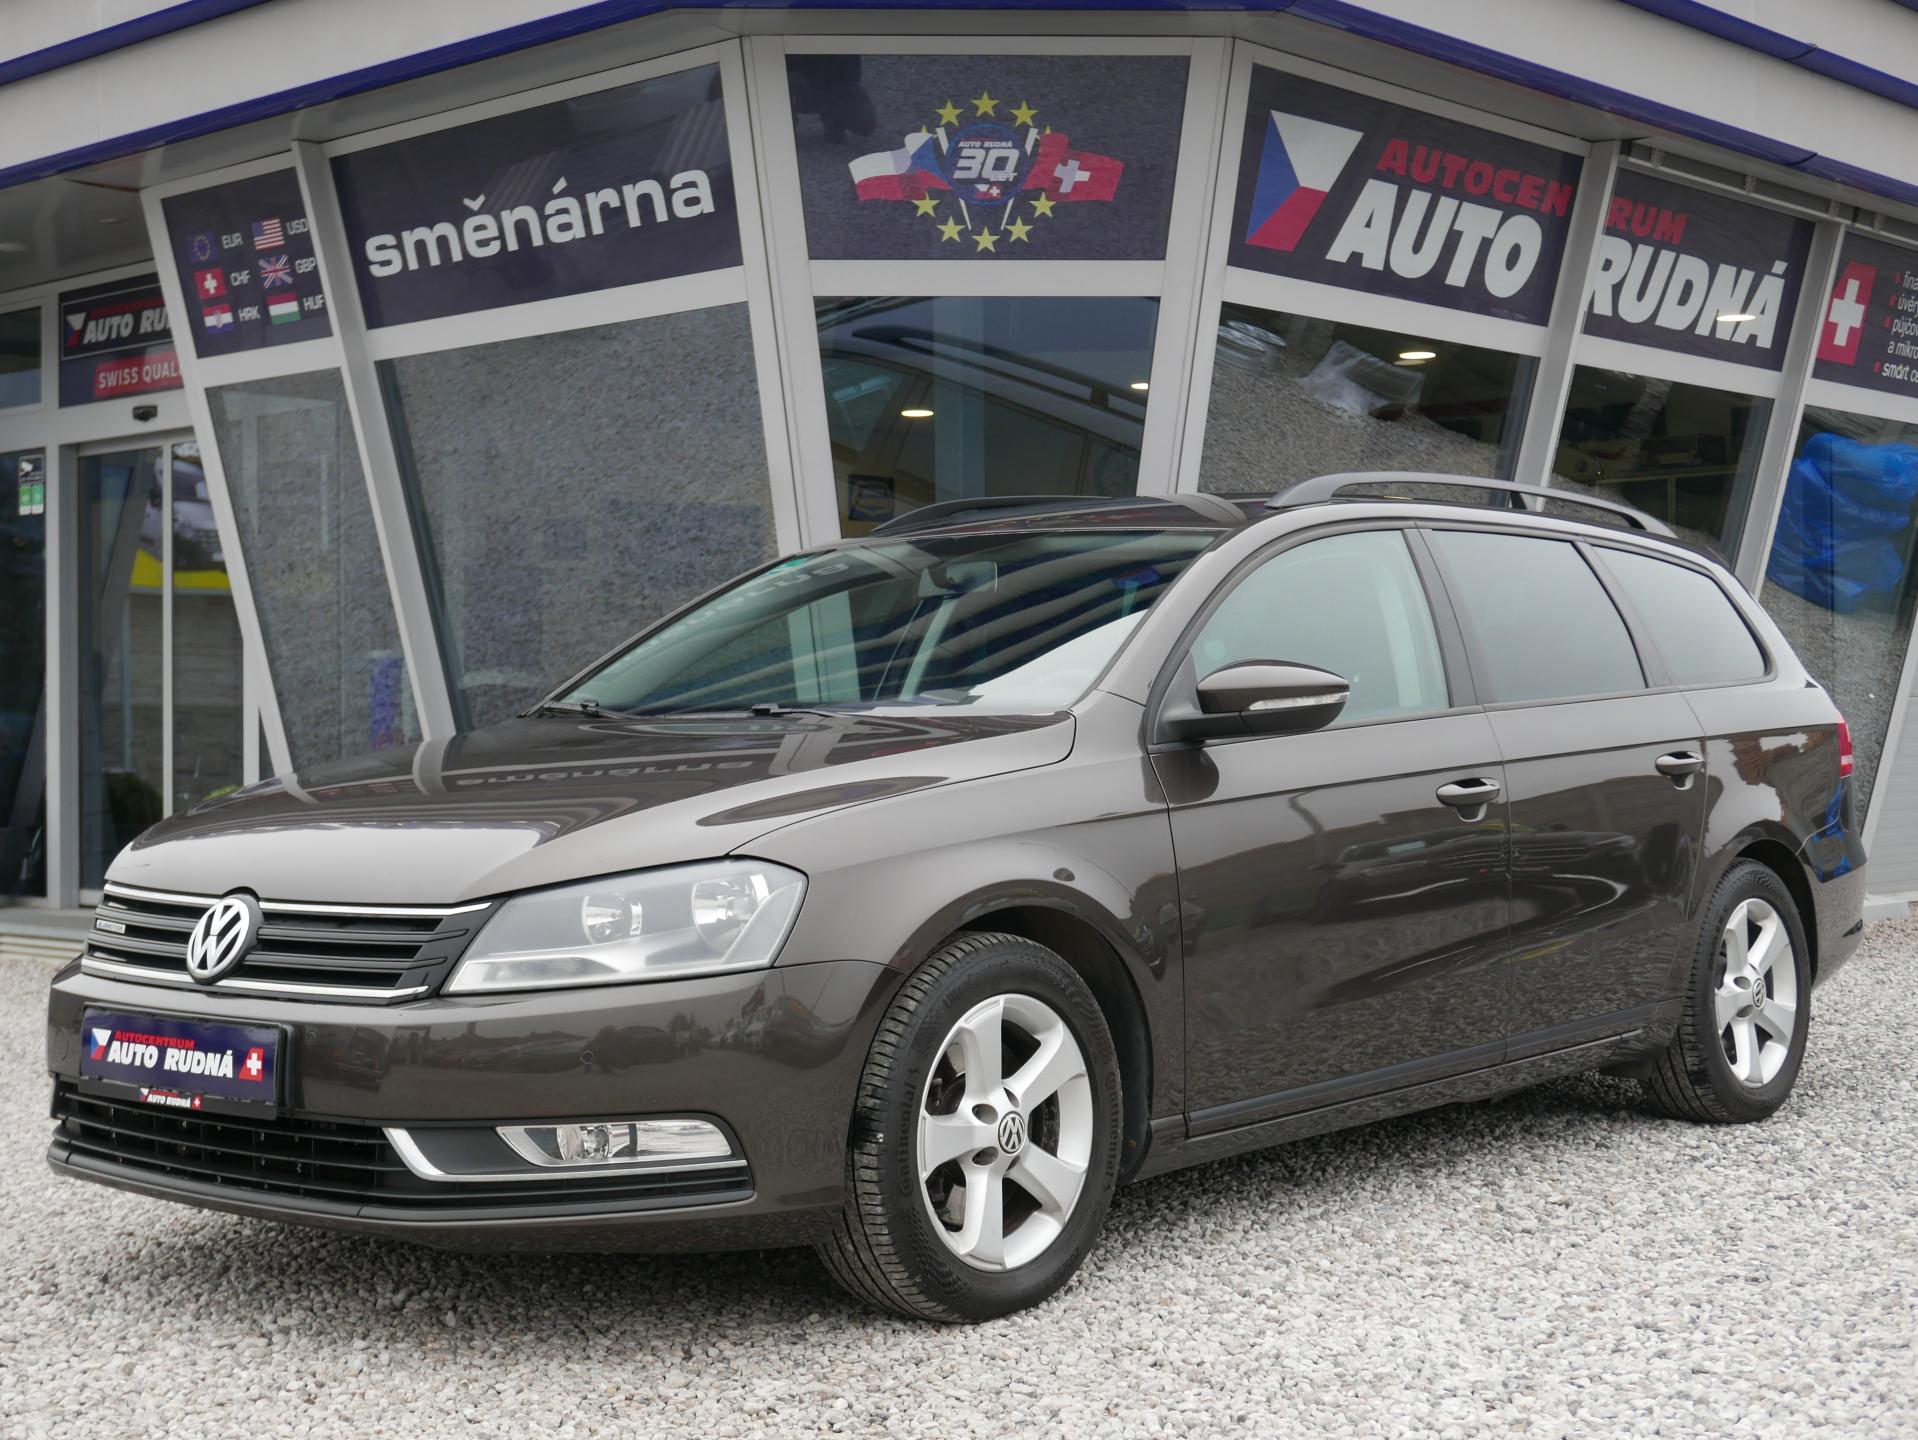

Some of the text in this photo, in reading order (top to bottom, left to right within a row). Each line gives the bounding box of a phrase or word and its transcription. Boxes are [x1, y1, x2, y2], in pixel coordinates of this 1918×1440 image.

[952, 148, 1019, 179] 30
[286, 218, 309, 235] USD
[365, 169, 715, 278] směnárna
[221, 233, 244, 249] EUR
[294, 256, 316, 274] GBP
[1325, 178, 1789, 349] AUTO RUDNÁ
[230, 270, 251, 287] CHF
[303, 294, 325, 312] HUF
[83, 312, 134, 345] AUTO
[139, 306, 170, 334] RU
[98, 361, 181, 389] SWISS QUAL
[114, 1031, 195, 1050] AUTOCENTRUM
[107, 1041, 233, 1078] AUTO RUDNÁ
